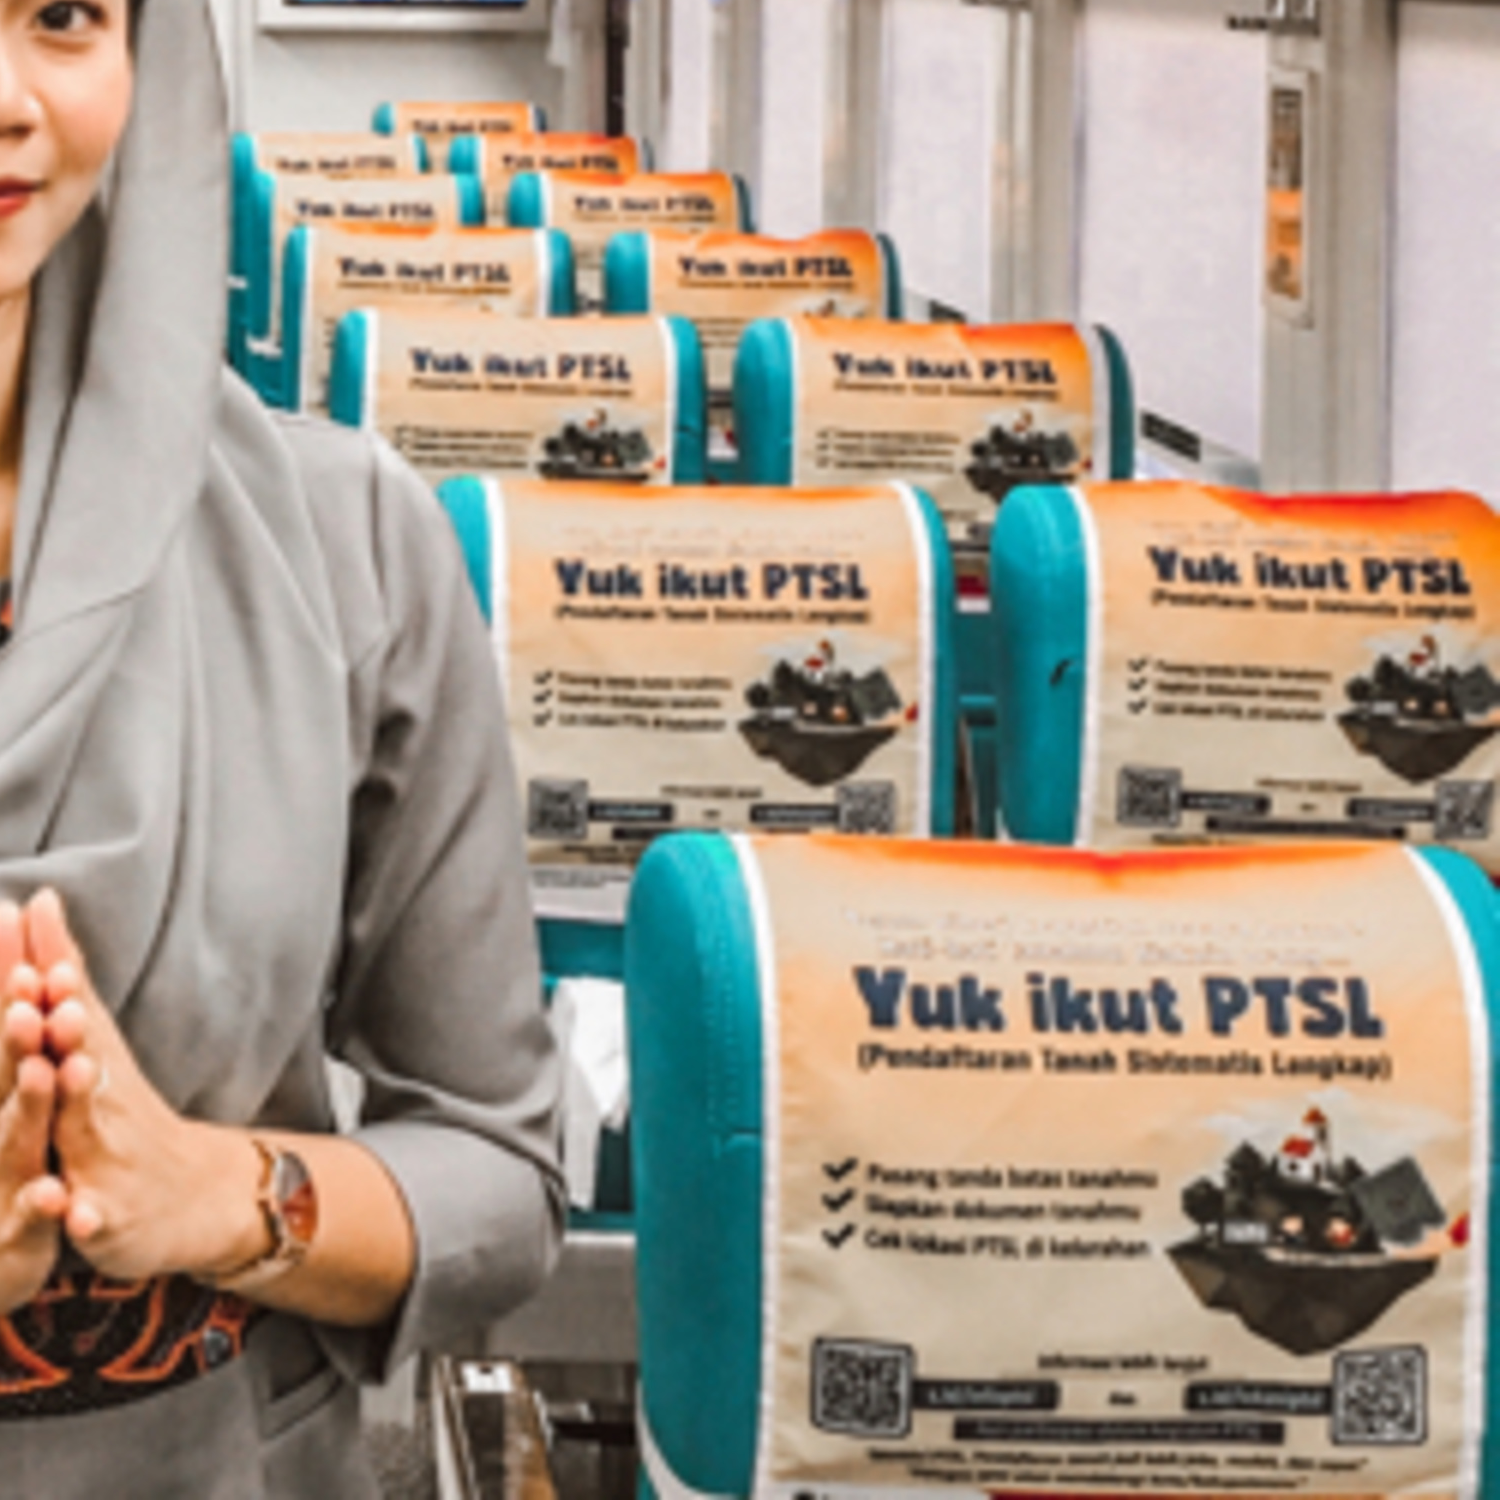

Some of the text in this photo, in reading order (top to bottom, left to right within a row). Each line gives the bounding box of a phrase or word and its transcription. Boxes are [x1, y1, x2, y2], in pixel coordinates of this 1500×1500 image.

[409, 348, 632, 382] Yuk ikut PTSL
[832, 353, 1058, 384] Yuk ikut PTSL
[556, 559, 870, 601] Yuk ikut PTSL
[1147, 546, 1471, 596] Yuk ikut PTSL
[854, 968, 1382, 1038] Yuk ikut PTSL
[857, 1042, 1394, 1083] (Pendaftaran Tanah Sistematis Lengkap)
